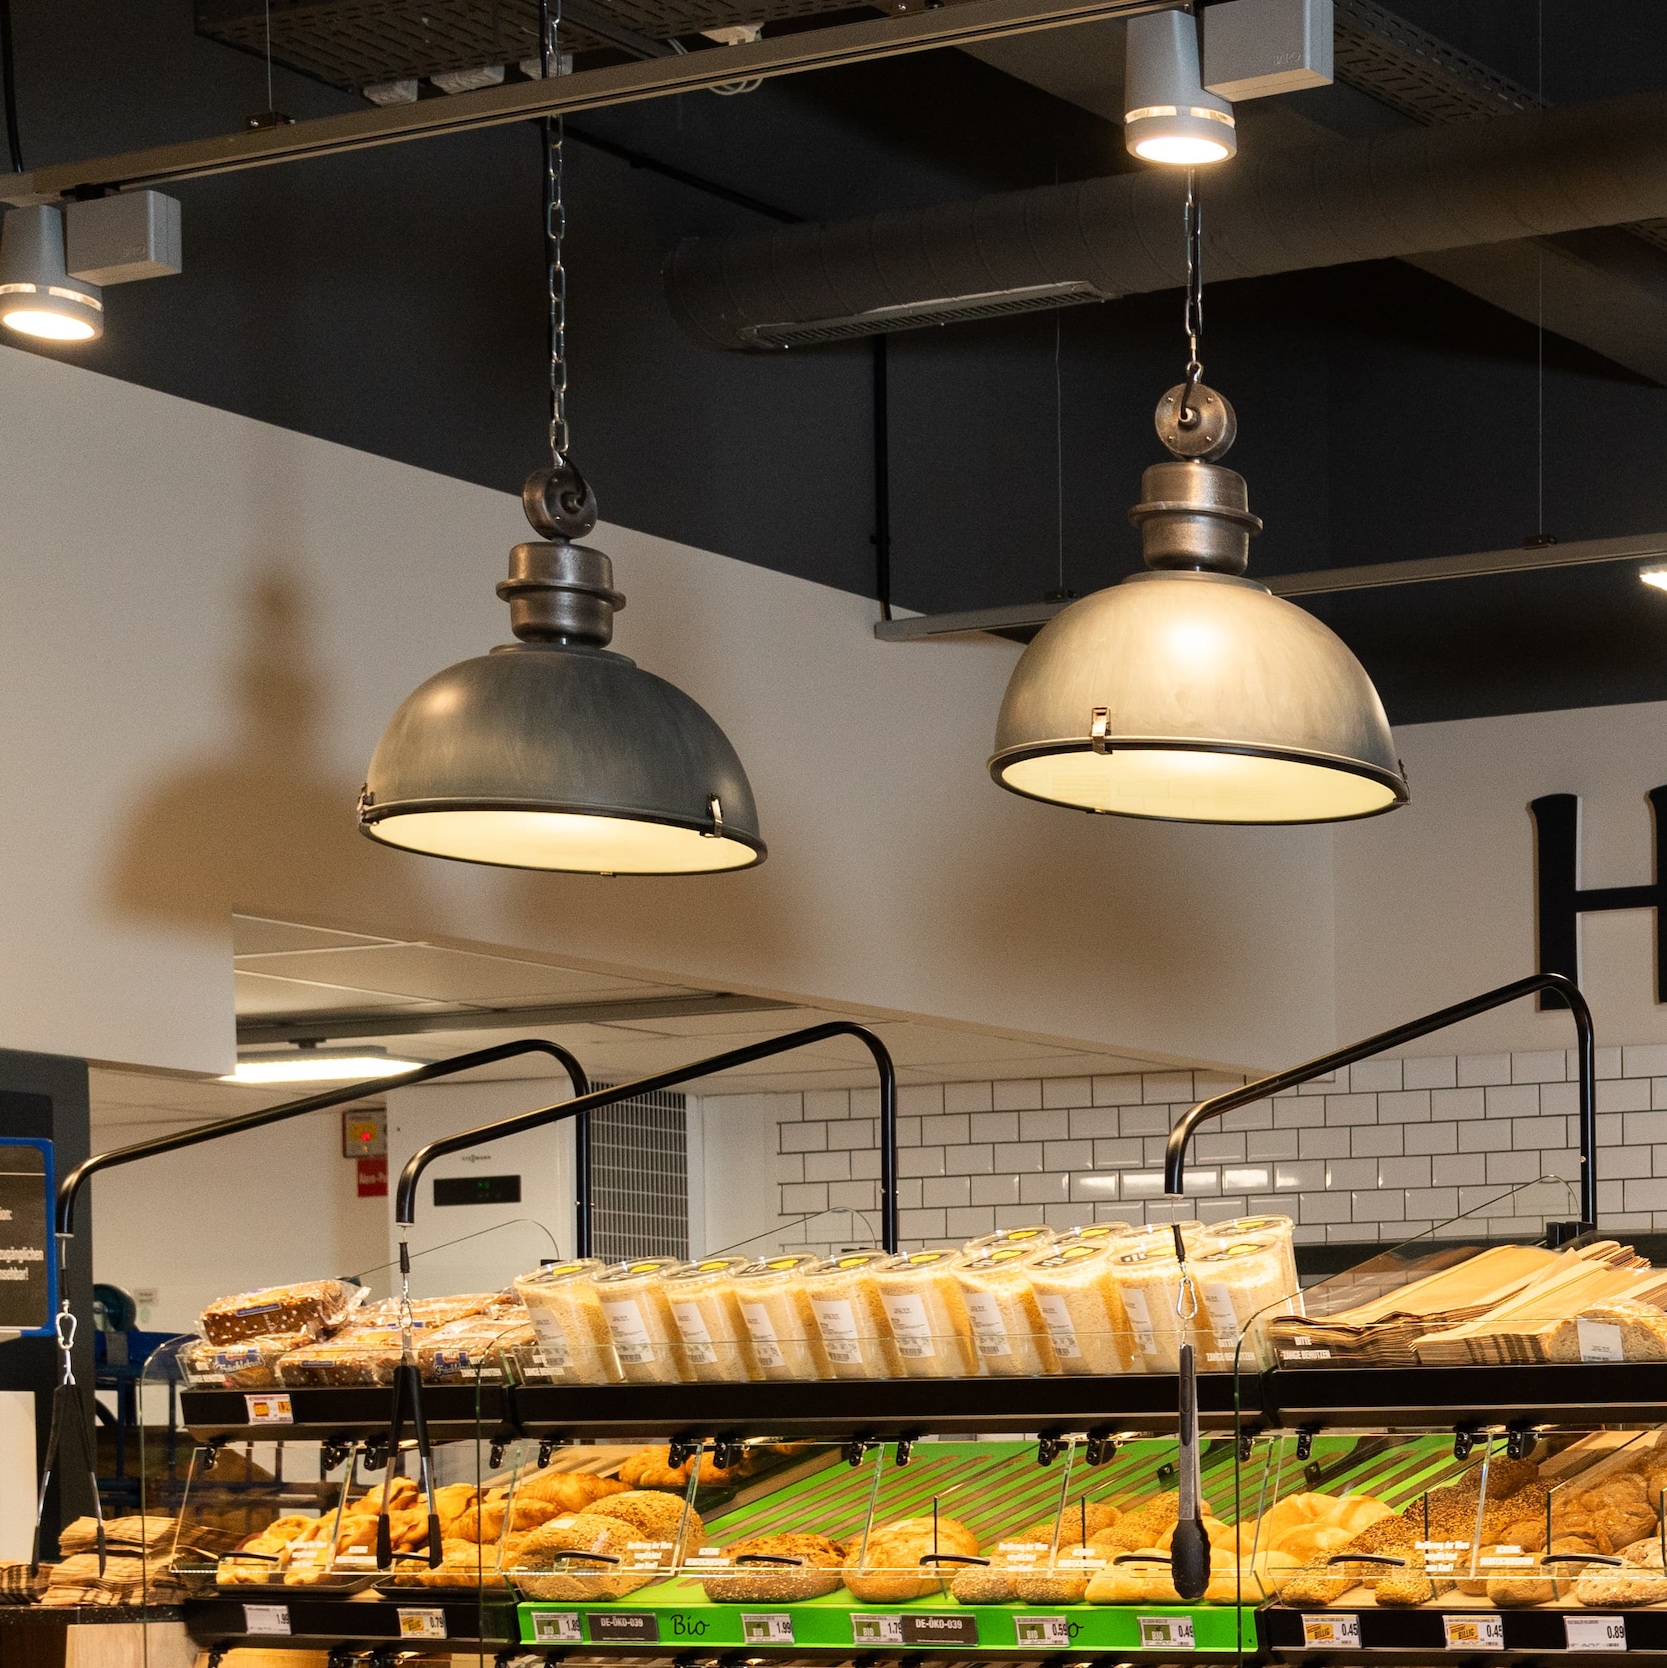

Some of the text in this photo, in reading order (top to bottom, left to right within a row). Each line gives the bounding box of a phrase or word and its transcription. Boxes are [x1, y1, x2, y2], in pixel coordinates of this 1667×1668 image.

[601, 1616, 643, 1629] DE-ÖKO-039
[671, 1613, 710, 1637] Bio
[914, 1617, 963, 1630] DE-ÖKO-039
[1341, 1622, 1359, 1638] 0.45
[1606, 1624, 1625, 1640] 0.89
